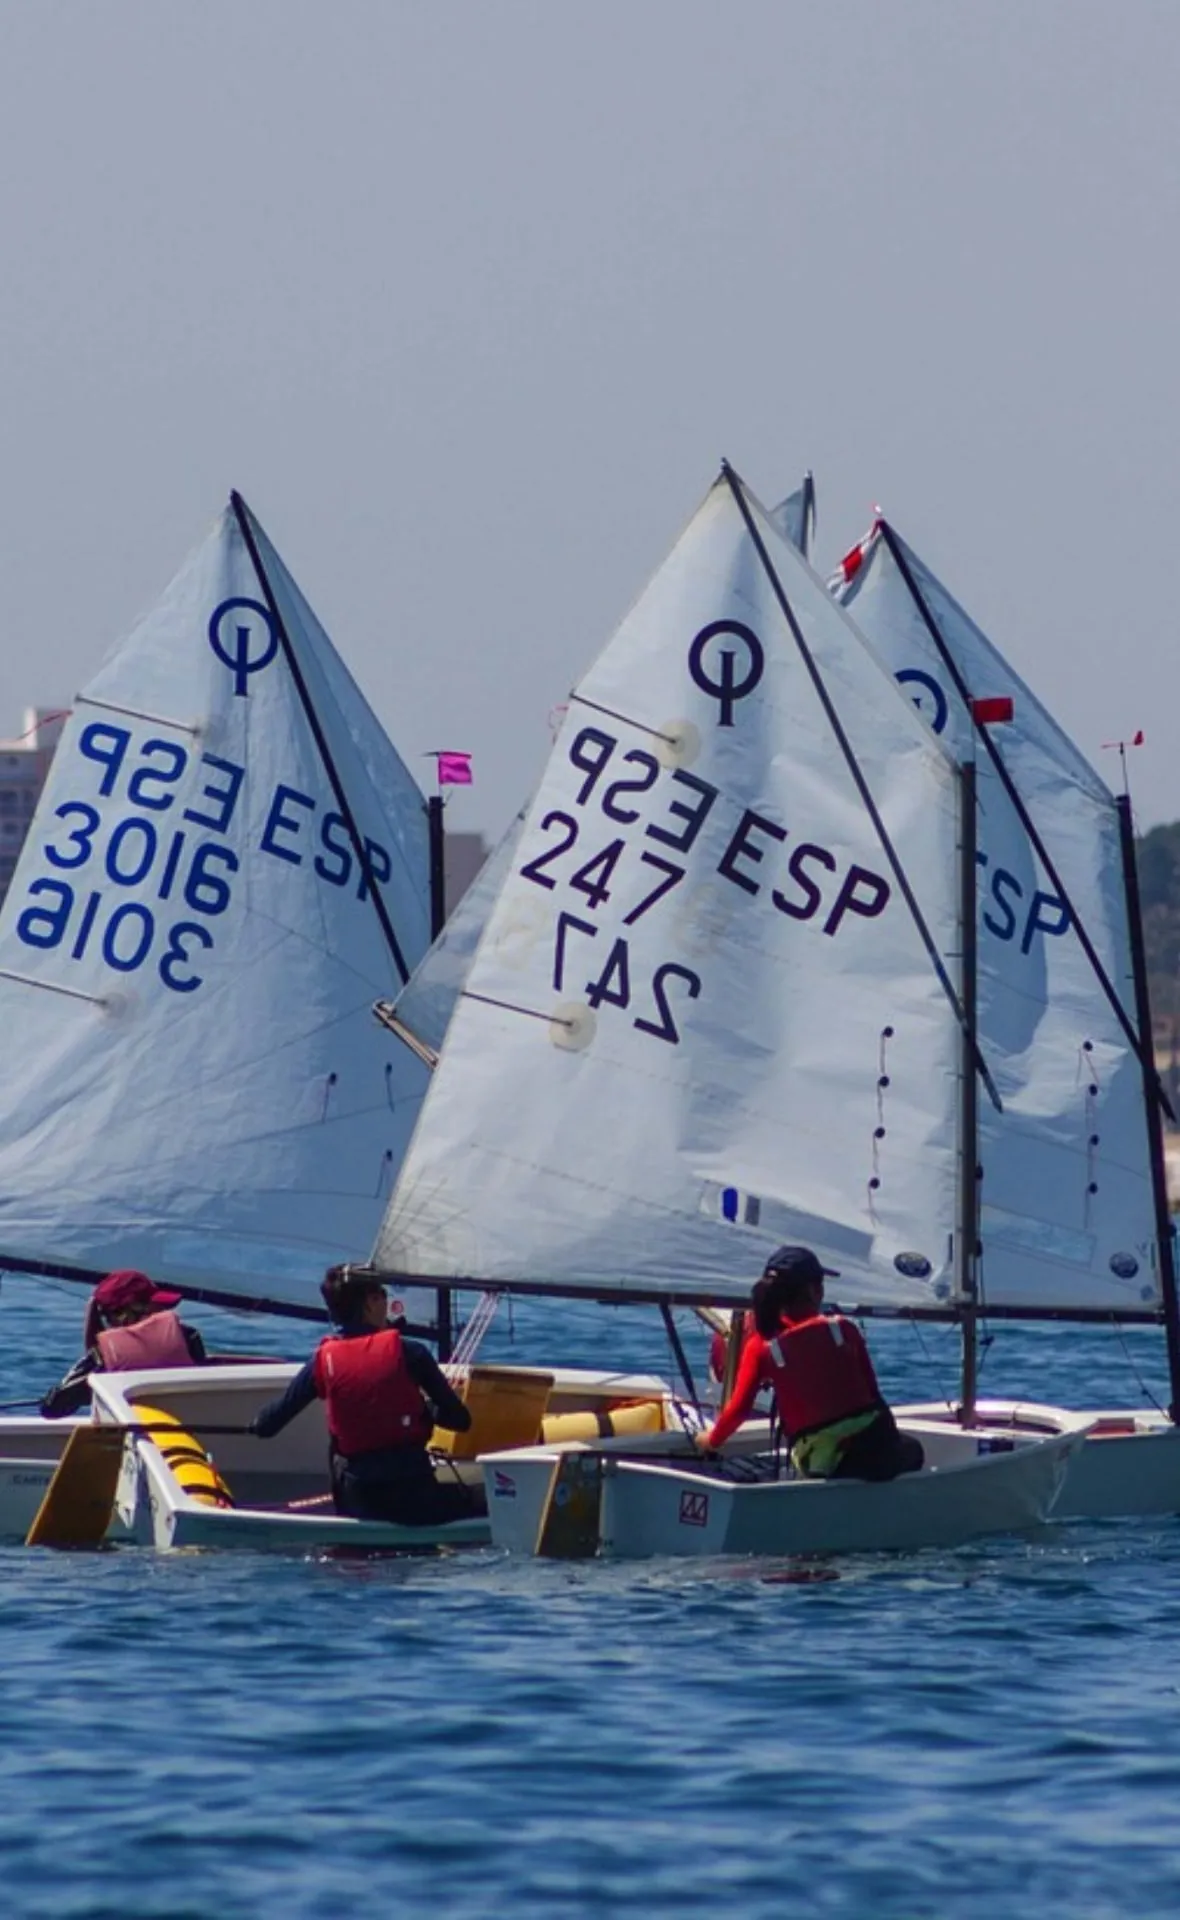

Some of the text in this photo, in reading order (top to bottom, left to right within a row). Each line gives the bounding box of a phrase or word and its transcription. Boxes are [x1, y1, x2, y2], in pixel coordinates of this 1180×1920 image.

[44, 802, 239, 915] 3016
[260, 785, 392, 901] ESP
[520, 810, 686, 926] 247
[717, 809, 891, 937] ESP
[976, 851, 1072, 955] SP
